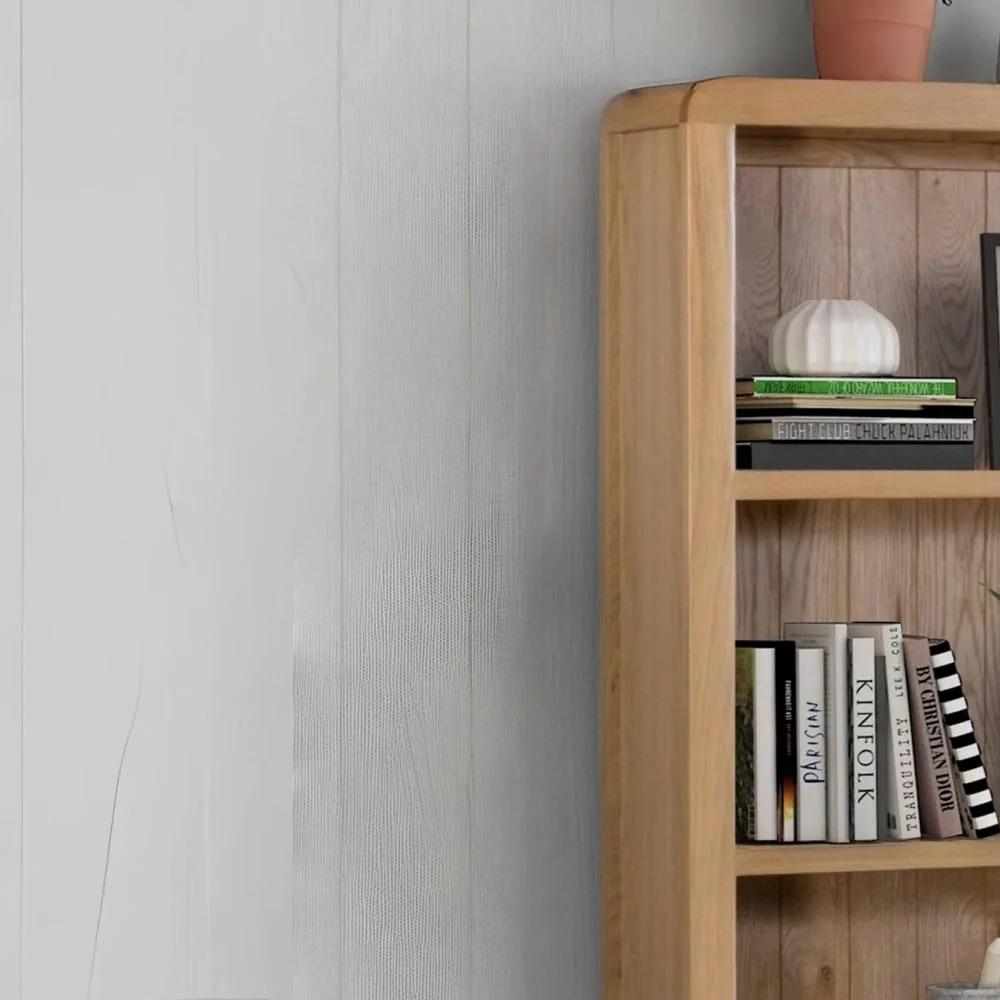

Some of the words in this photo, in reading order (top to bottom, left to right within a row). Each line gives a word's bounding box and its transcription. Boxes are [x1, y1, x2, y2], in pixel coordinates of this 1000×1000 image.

[777, 422, 814, 441] FIGHT
[818, 422, 850, 441] CLUB
[855, 423, 896, 441] CHUCK
[900, 423, 970, 441] PALAHNIUK
[889, 626, 900, 655] COLE
[894, 675, 904, 698] LEE
[916, 666, 932, 686] BY
[800, 701, 825, 784] PARISIAN
[855, 679, 875, 803] KINFOLK
[920, 689, 948, 770] CHRISTIAN
[896, 717, 918, 832] TRANQUILITY
[935, 772, 955, 812] DIOR
